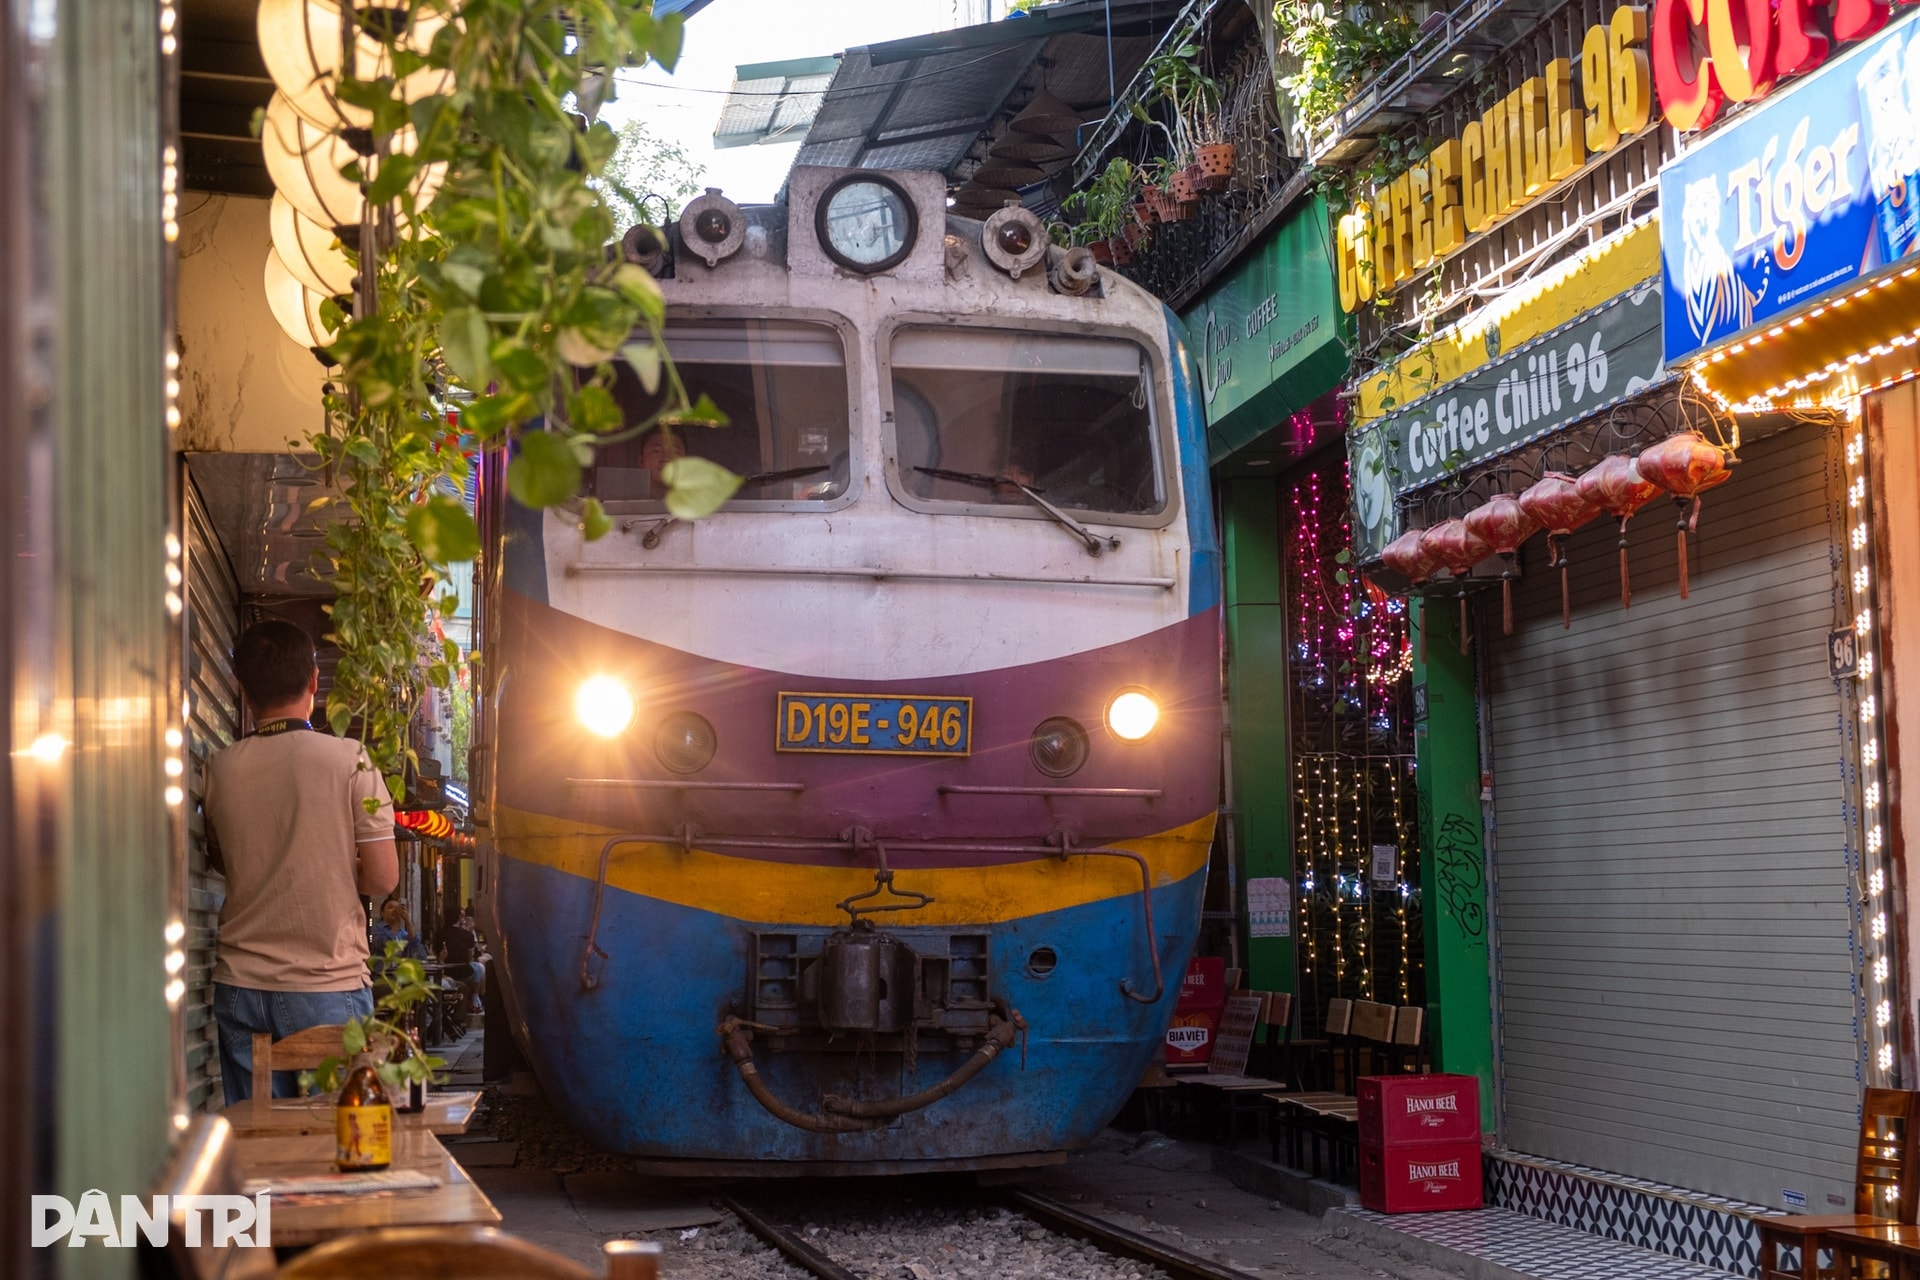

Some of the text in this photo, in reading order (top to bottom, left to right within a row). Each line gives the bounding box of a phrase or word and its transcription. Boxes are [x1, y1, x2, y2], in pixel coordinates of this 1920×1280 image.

[1337, 5, 1650, 313] COFFEE CHILL 96
[1727, 115, 1858, 270] Tiger
[1246, 292, 1278, 339] COFFEE
[1408, 331, 1608, 473] Coffee Chill 96
[1834, 636, 1853, 669] 96
[787, 701, 870, 744] D19E
[897, 704, 961, 746] 946
[1169, 1032, 1185, 1042] BIA
[1406, 1095, 1457, 1113] HANOI BEER
[1409, 1162, 1460, 1180] HANOI BEER
